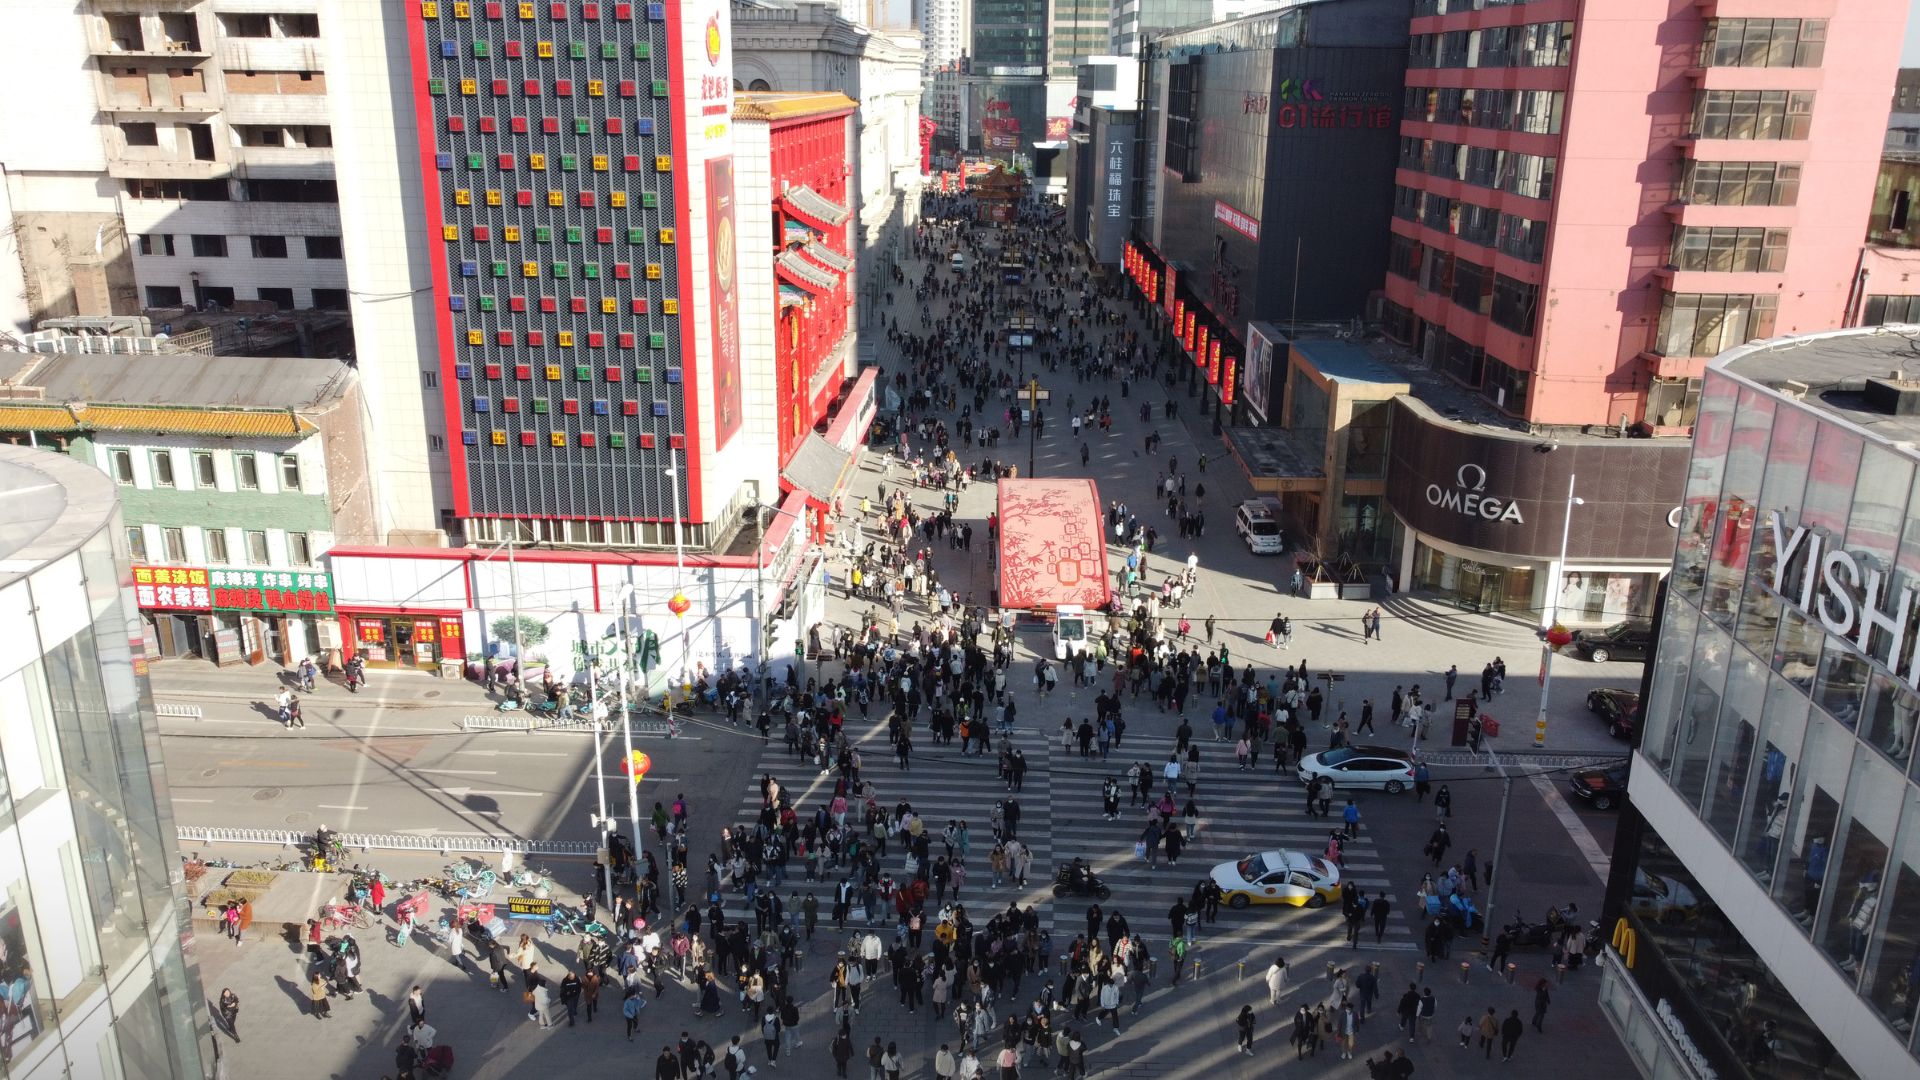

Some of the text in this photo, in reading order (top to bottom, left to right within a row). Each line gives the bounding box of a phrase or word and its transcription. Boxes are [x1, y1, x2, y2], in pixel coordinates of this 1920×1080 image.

[1278, 103, 1391, 129] 01流行馆
[1107, 140, 1124, 217] 六桂福珠宝
[1426, 484, 1524, 524] OMEGA
[211, 570, 328, 589] 麻辣拌 炸串 烤串
[137, 585, 210, 608] 面农家菜
[213, 587, 331, 611] 麻辣烫 鸭血粉丝
